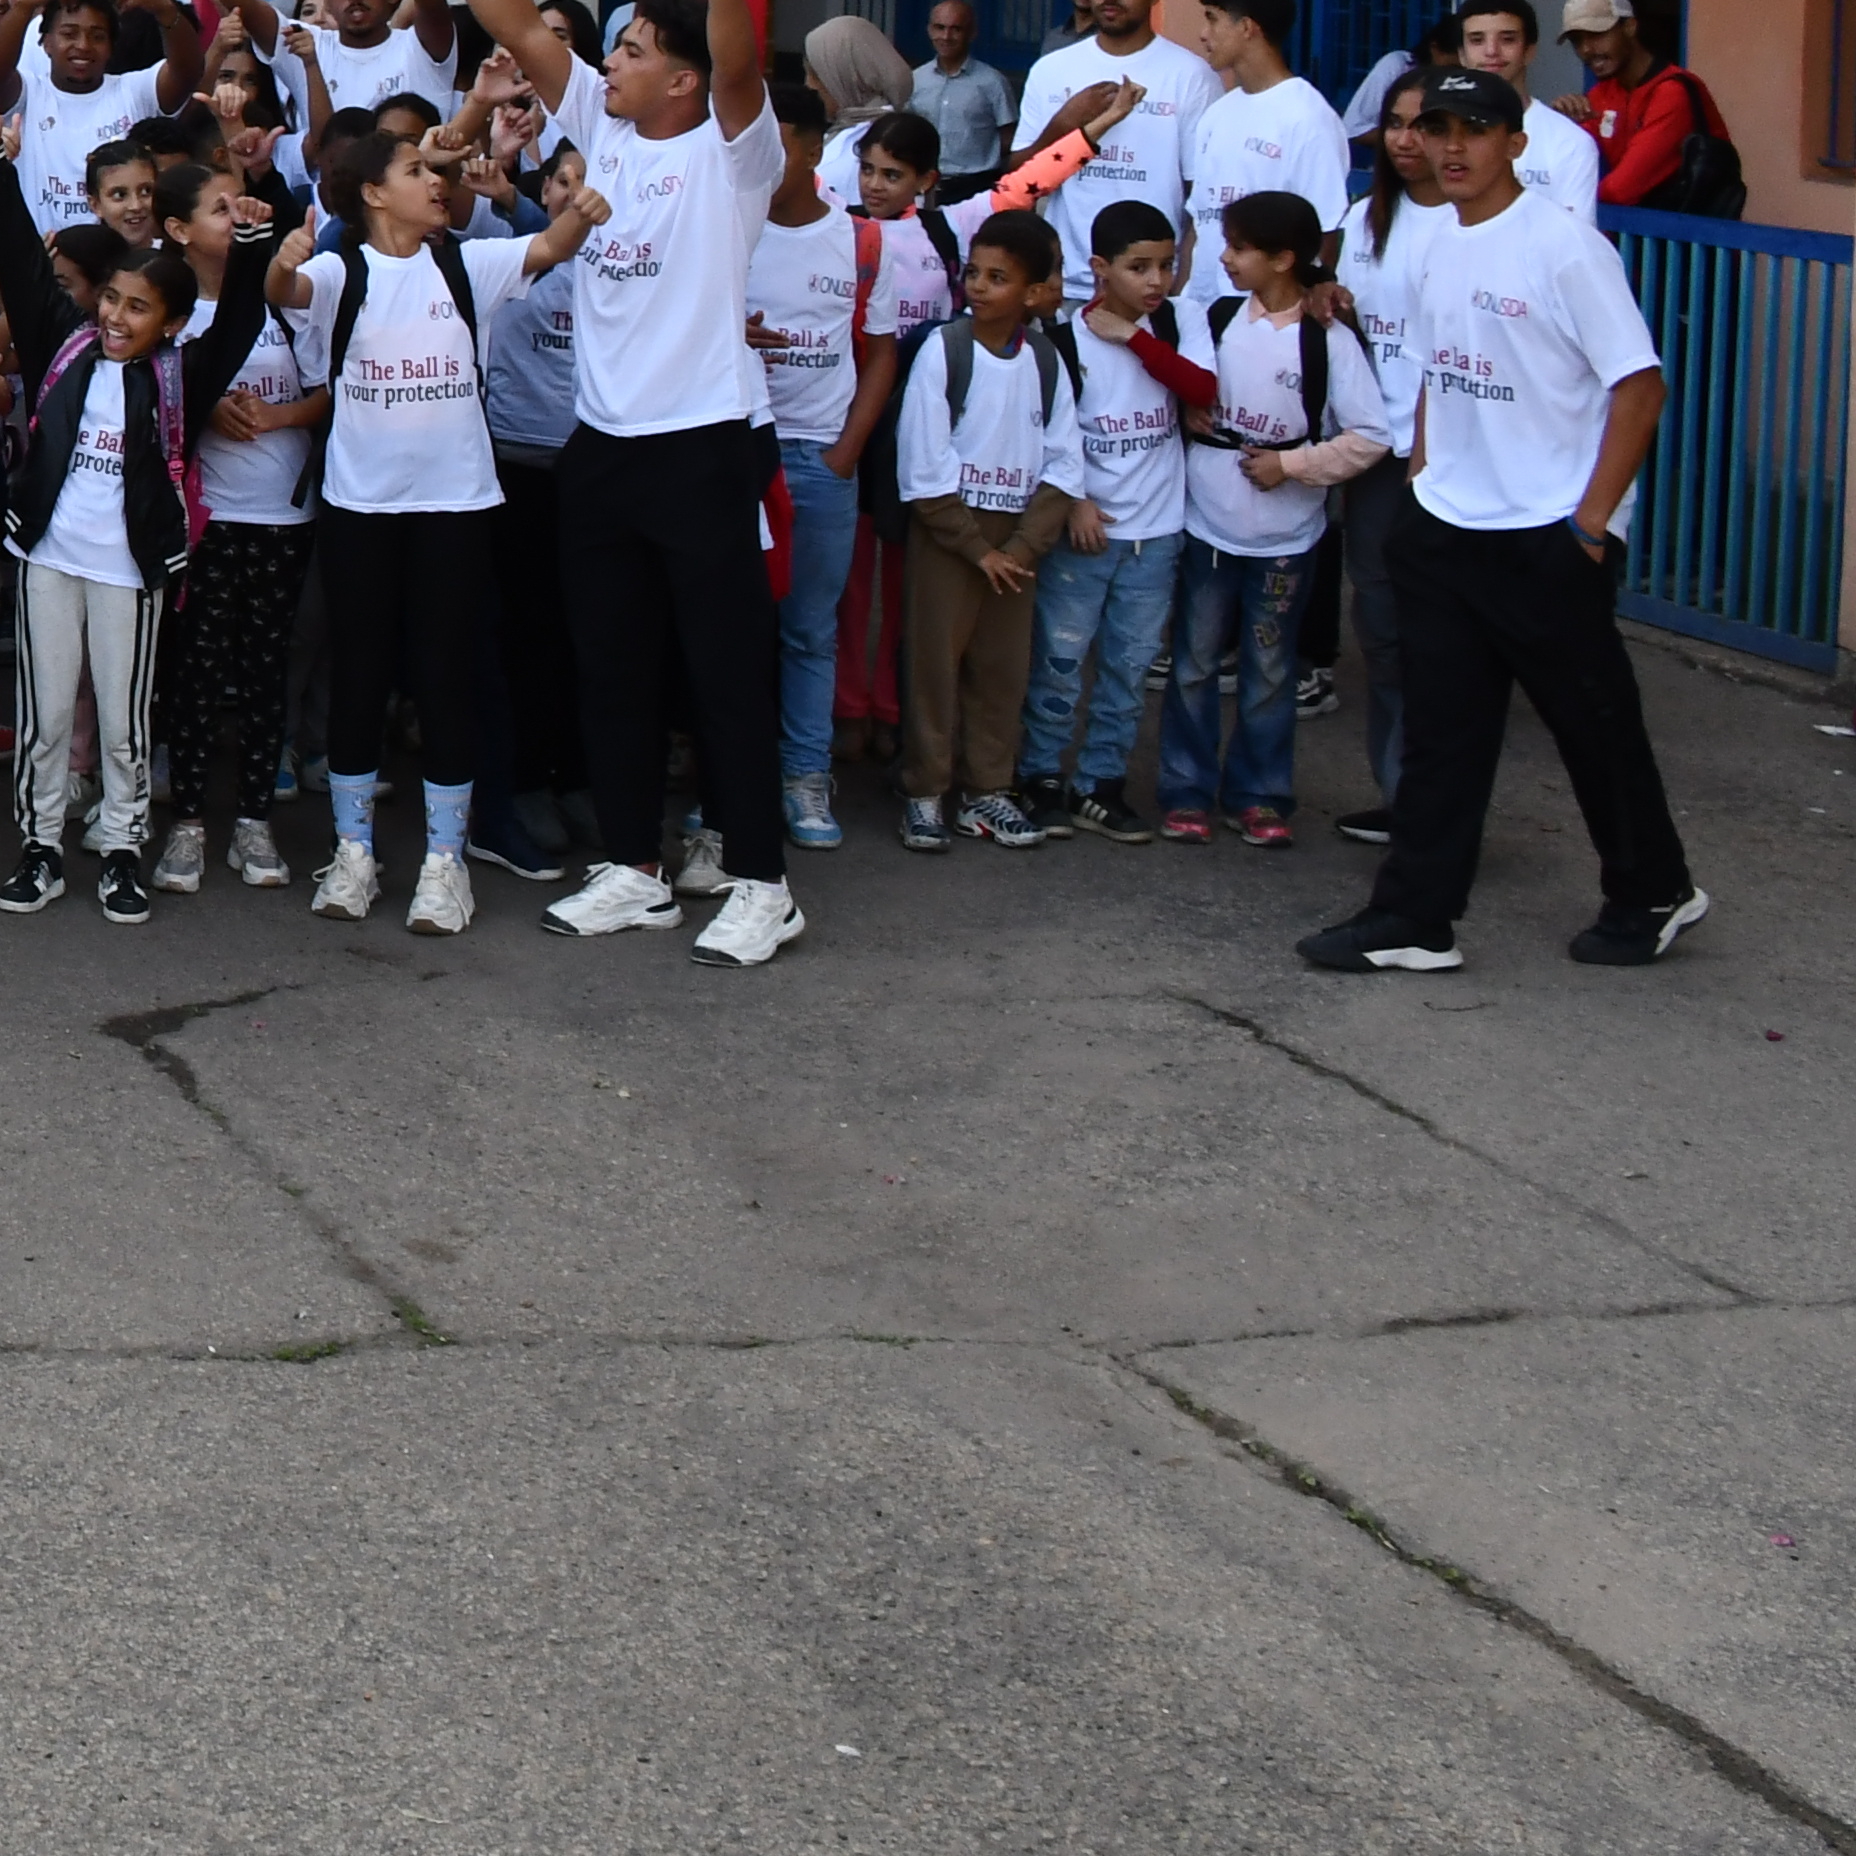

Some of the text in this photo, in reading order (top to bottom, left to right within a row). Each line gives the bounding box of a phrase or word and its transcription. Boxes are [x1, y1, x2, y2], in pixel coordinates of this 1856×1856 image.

[1122, 146, 1135, 163] is
[1078, 161, 1147, 182] protection
[898, 299, 929, 320] Ball
[1363, 314, 1396, 335] The
[360, 354, 460, 380] The Ball is
[1475, 353, 1493, 376] is
[344, 378, 474, 409] your protection
[1094, 406, 1166, 434] The Ball
[1235, 406, 1270, 436] Ball
[1272, 417, 1288, 438] is
[960, 462, 991, 485] The
